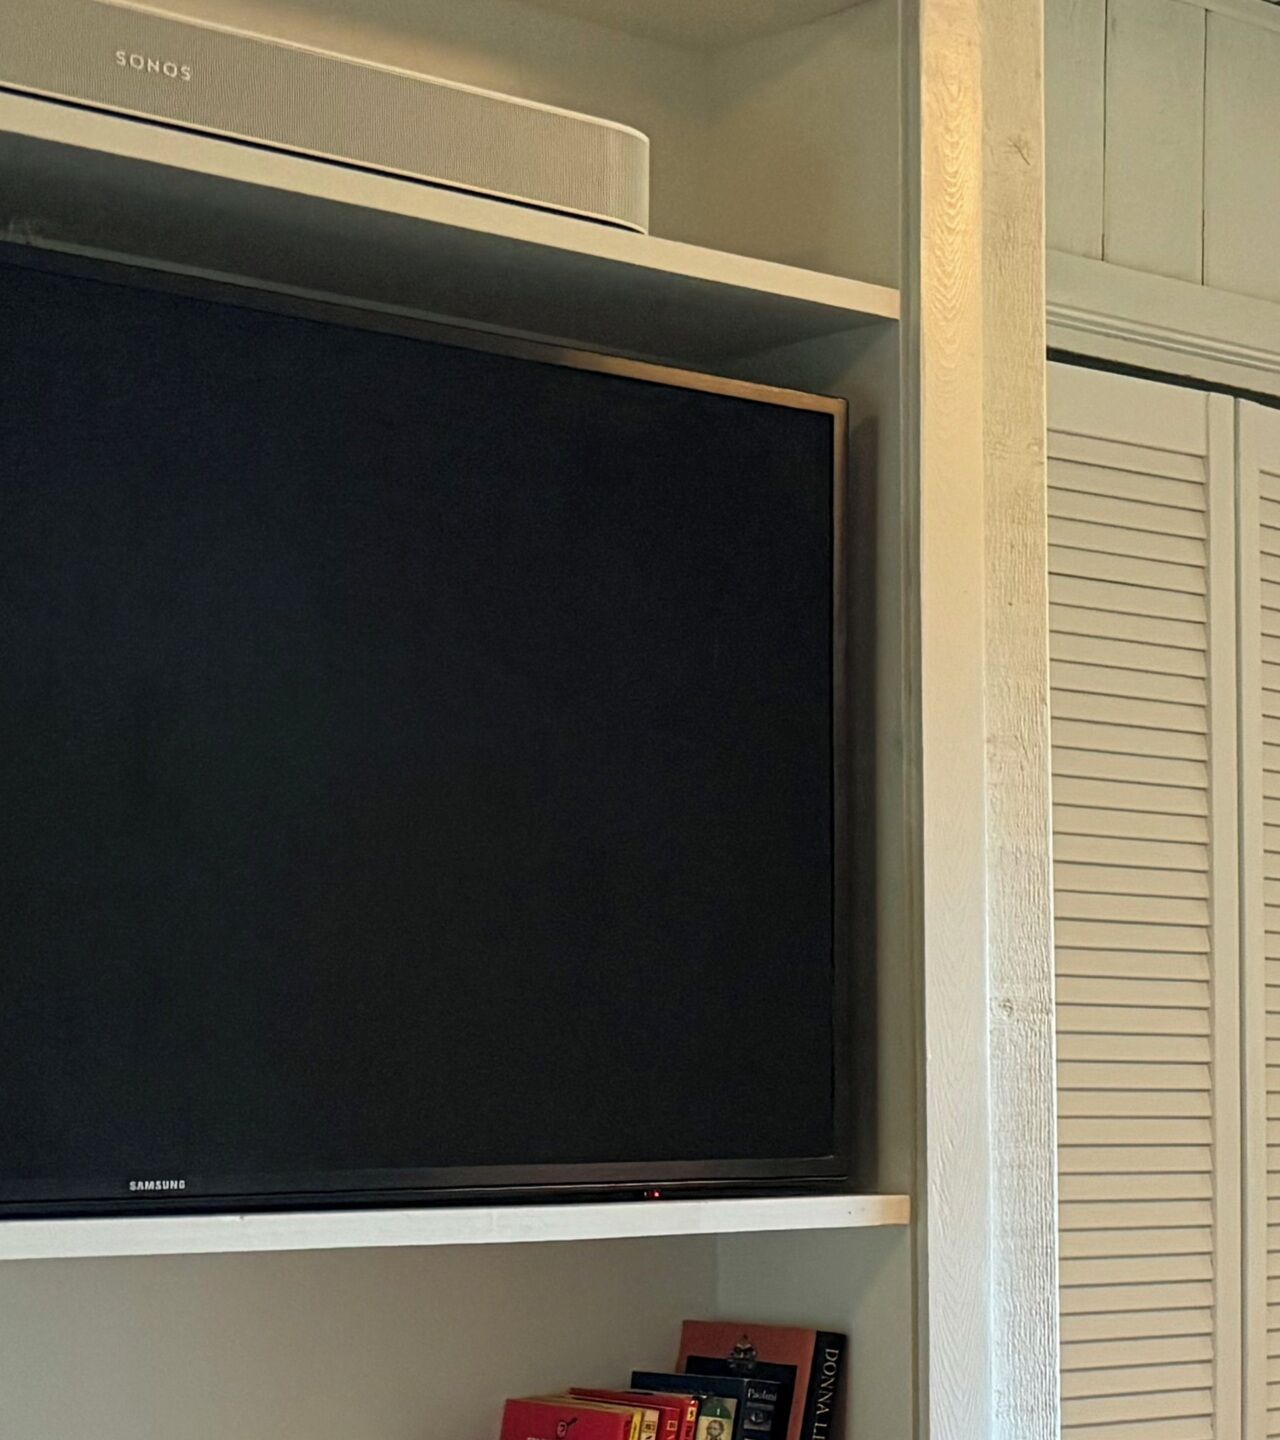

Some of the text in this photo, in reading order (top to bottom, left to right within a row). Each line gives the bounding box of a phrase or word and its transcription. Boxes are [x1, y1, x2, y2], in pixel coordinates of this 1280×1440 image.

[115, 50, 191, 81] SONOS
[129, 1180, 186, 1191] SAMSUNG
[819, 1349, 839, 1415] DONNA
